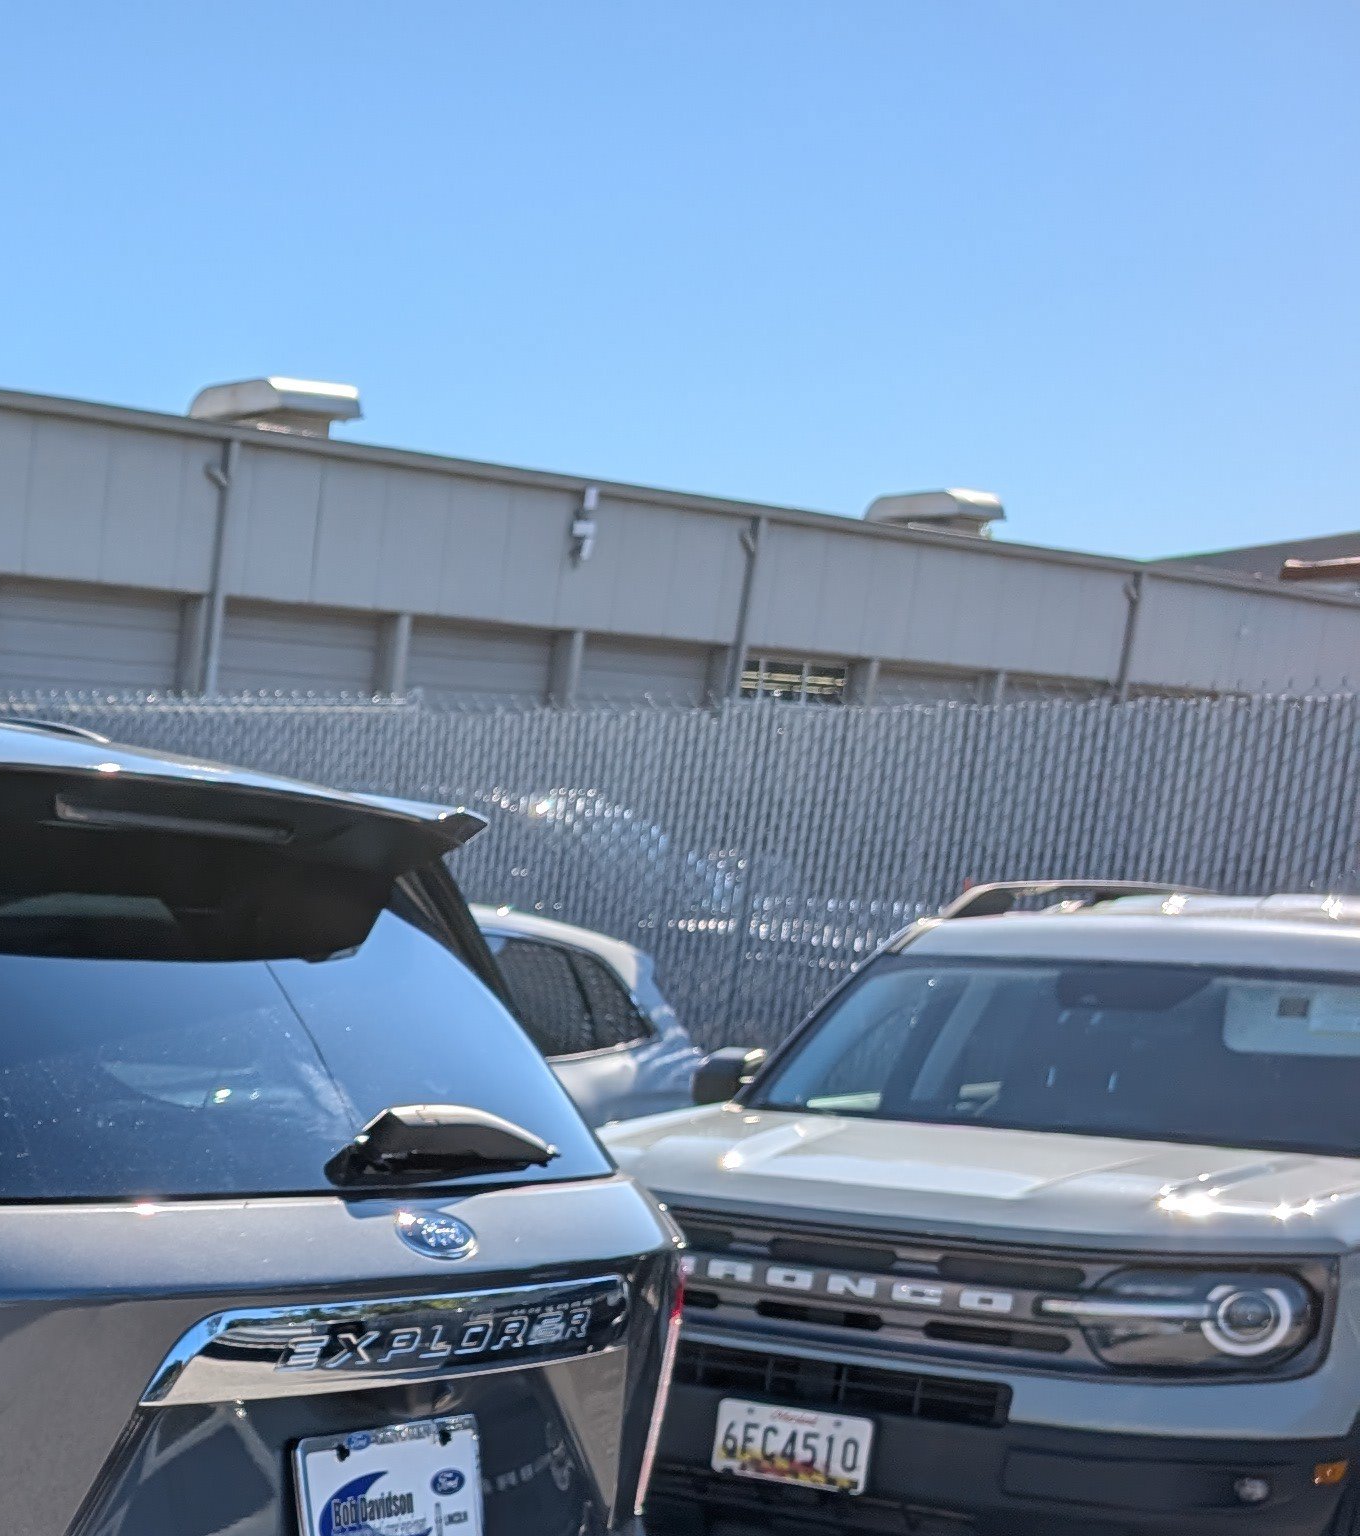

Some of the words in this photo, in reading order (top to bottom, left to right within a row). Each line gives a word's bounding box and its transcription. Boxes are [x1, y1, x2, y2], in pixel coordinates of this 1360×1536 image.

[274, 1306, 593, 1372] EXPLORER
[722, 1419, 860, 1477] 6FC4510
[332, 1496, 358, 1528] Bob
[359, 1490, 415, 1523] Davidson
